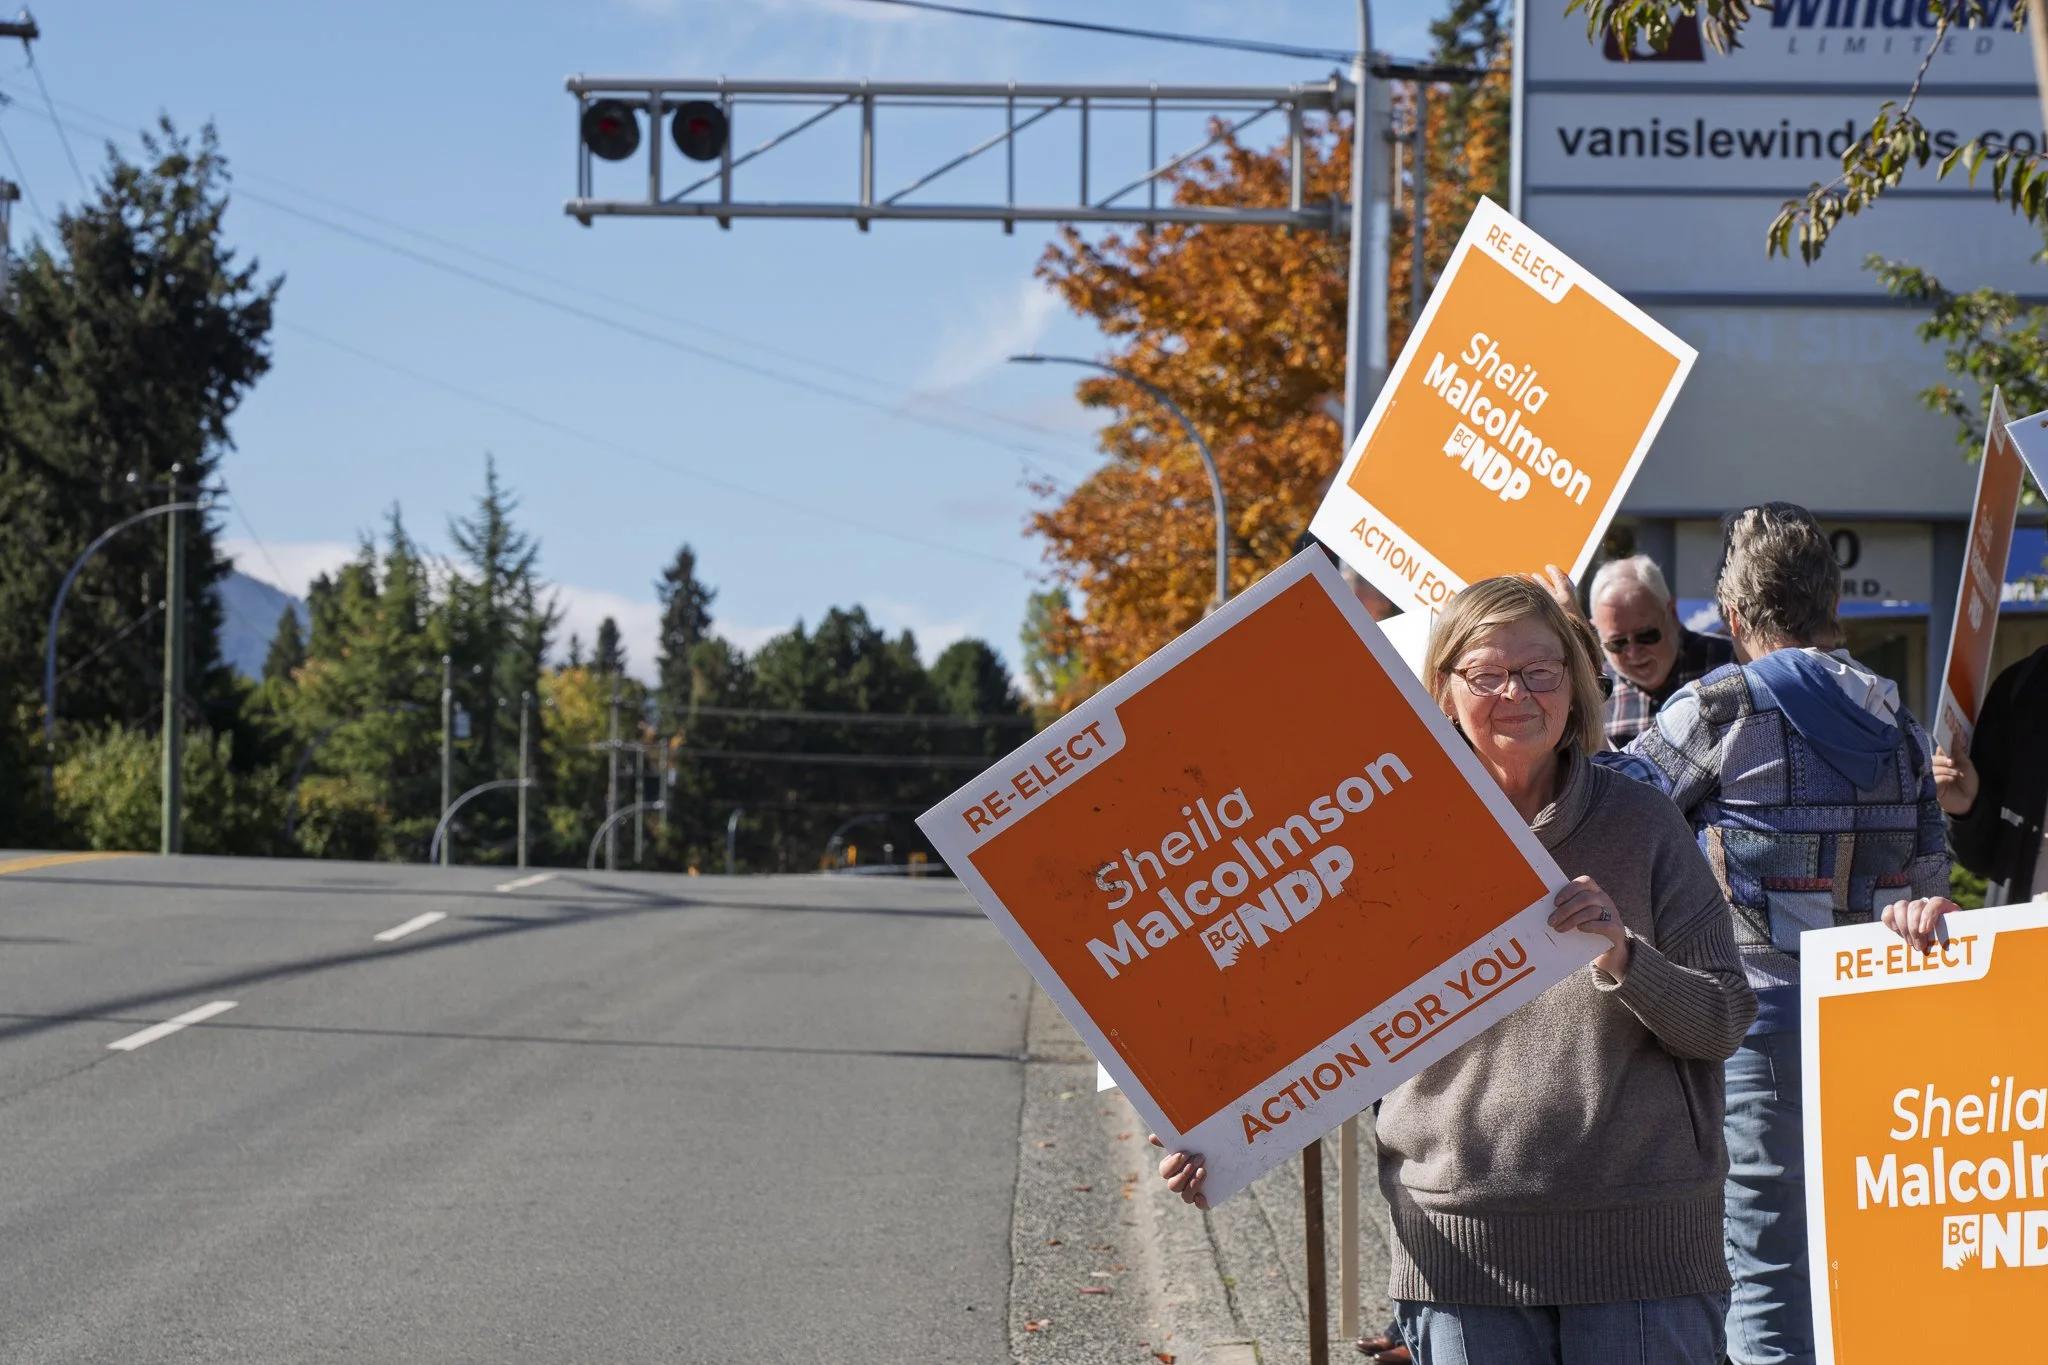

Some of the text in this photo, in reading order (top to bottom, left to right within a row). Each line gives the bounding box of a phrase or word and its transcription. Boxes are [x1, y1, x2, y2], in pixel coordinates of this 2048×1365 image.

[1787, 36, 1994, 54] LIMITED
[1486, 224, 1564, 291] RE-ELECT
[1461, 332, 1549, 414] Sheila
[1423, 352, 1591, 505] Malcolmson
[1454, 429, 1530, 502] BC NDP
[1350, 517, 1421, 582] ACTION
[961, 721, 1106, 834] RE-ELECT
[1085, 751, 1413, 979] Malcolmson
[1095, 787, 1253, 910] Sheila
[1208, 846, 1354, 950] BC NDP
[1836, 935, 1978, 980] RE-ELECT
[1241, 1044, 1369, 1144] ACTION
[1371, 994, 1448, 1056] FOR
[1446, 938, 1527, 1000] YOU
[1890, 1076, 2047, 1141] Sheila
[1948, 1222, 1975, 1245] BC
